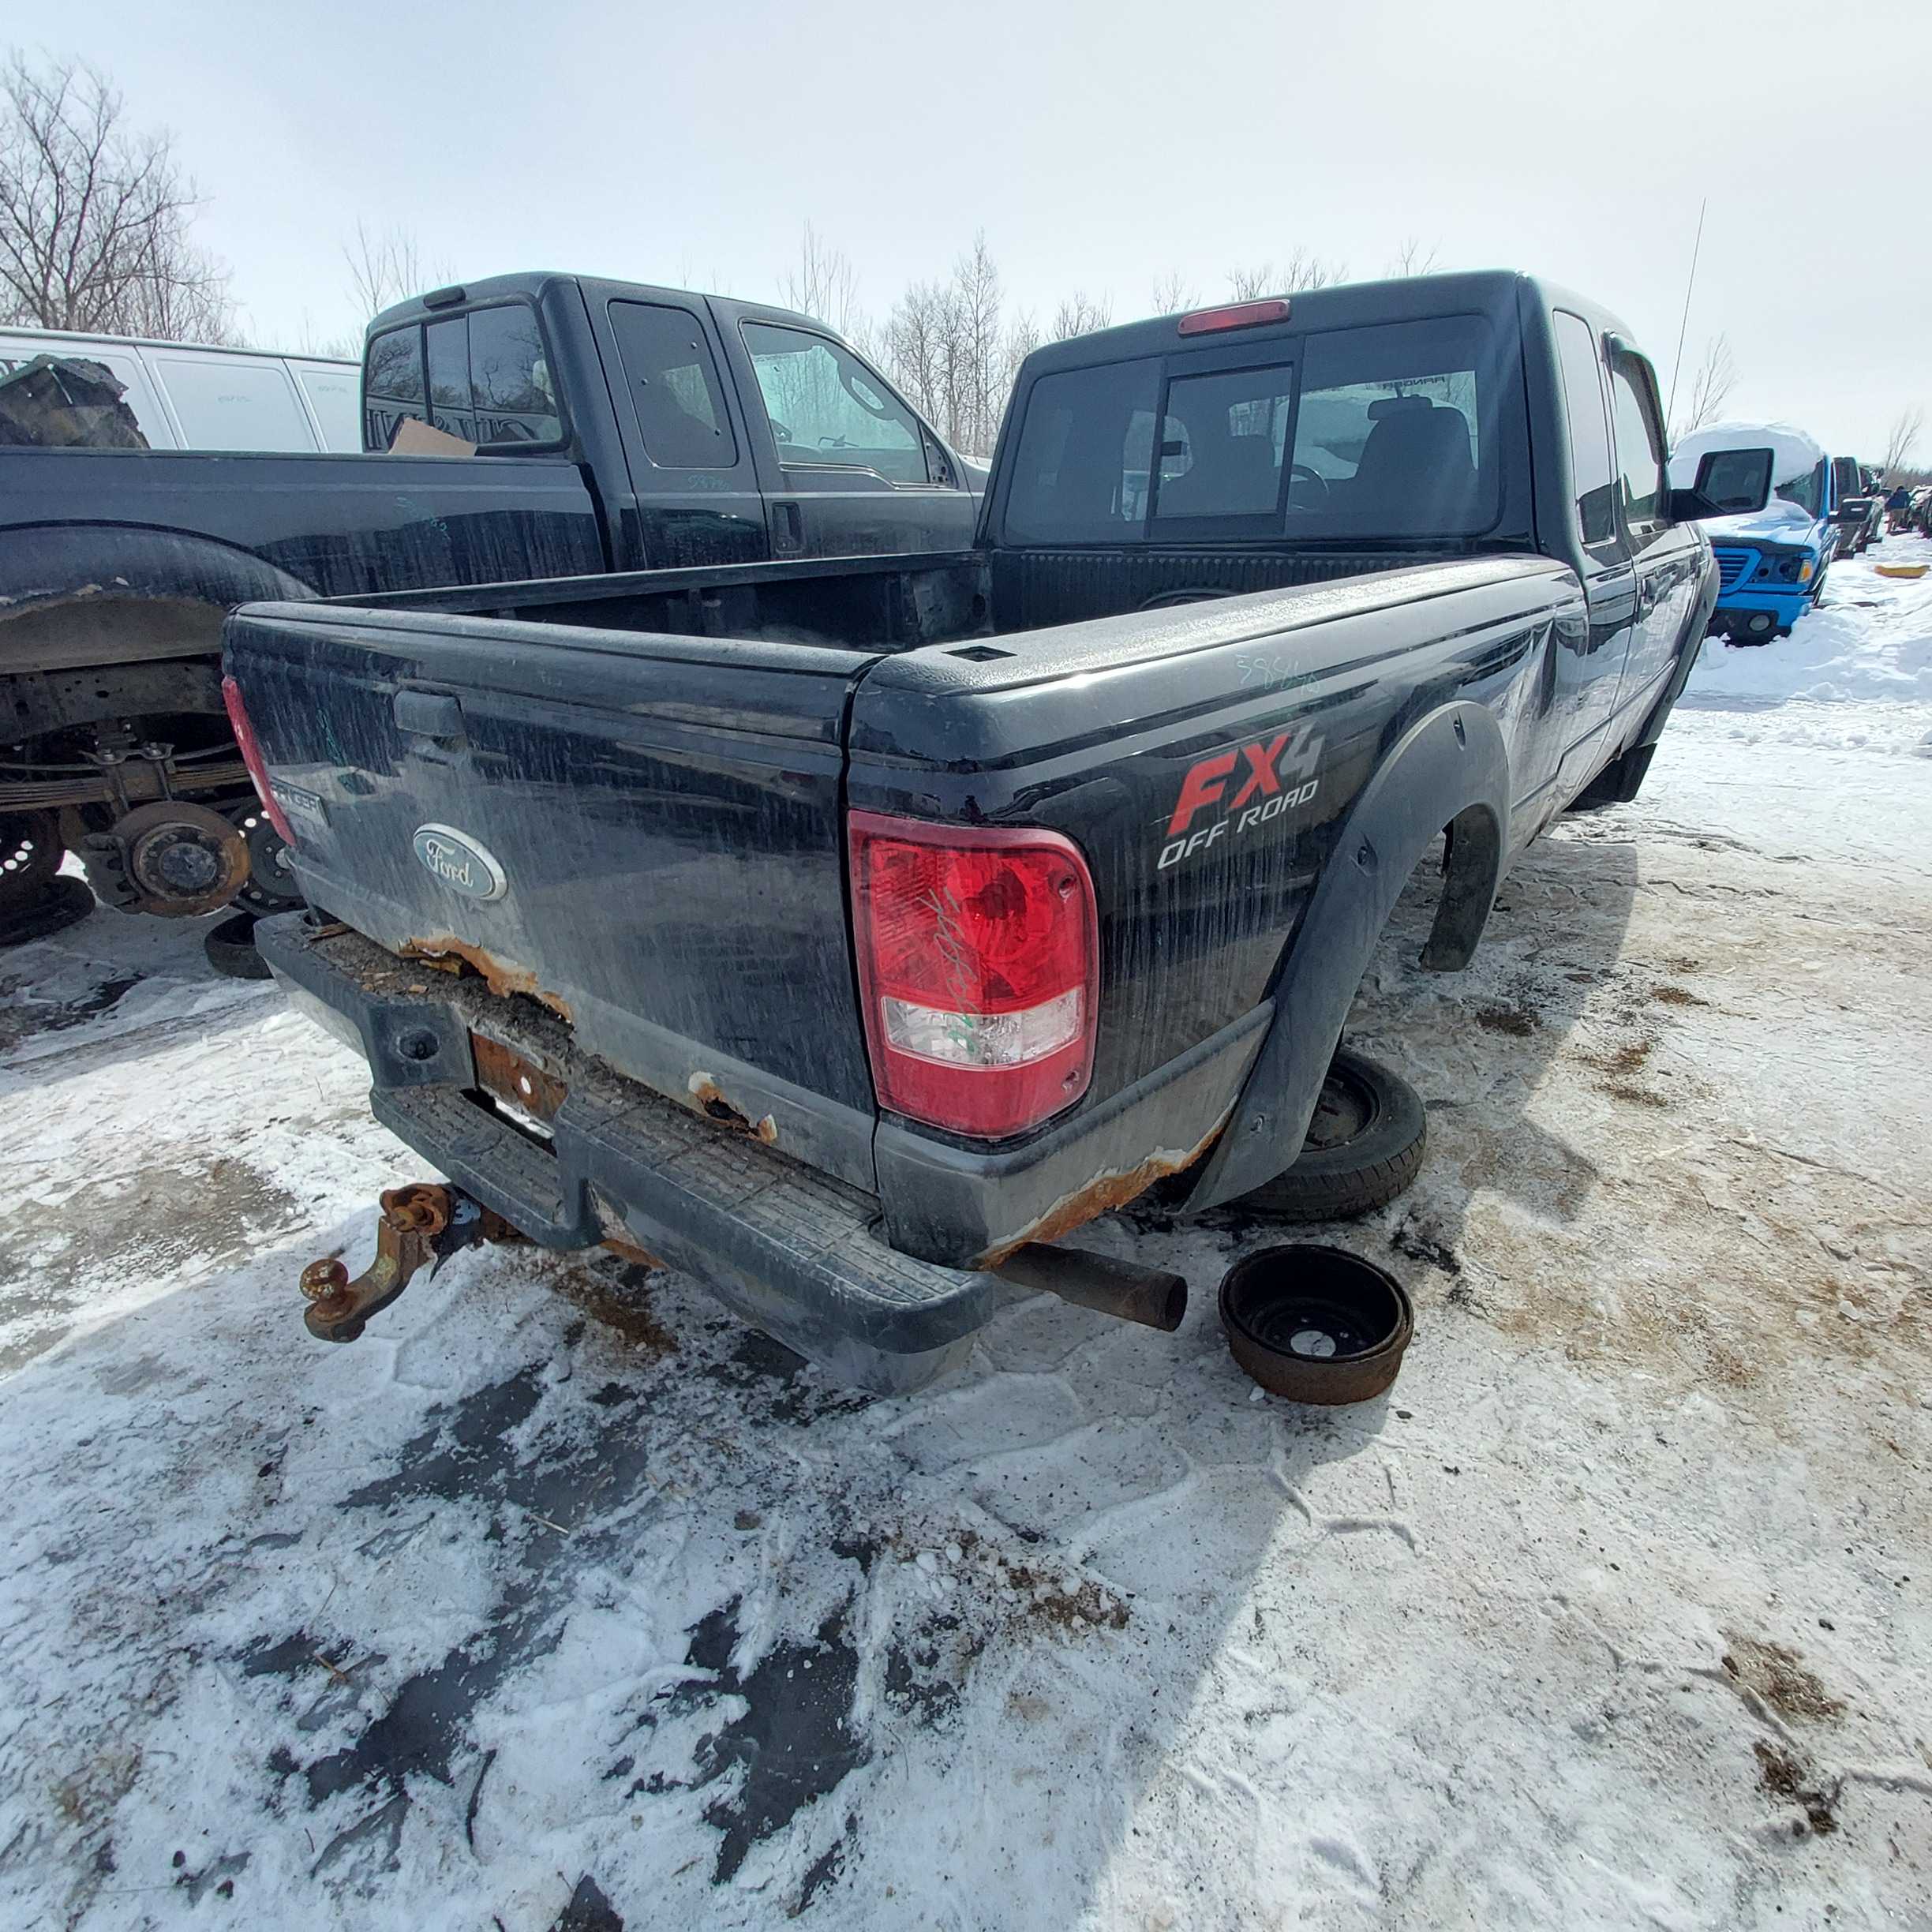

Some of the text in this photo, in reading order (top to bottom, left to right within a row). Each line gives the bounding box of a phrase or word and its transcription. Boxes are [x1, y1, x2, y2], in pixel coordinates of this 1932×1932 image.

[1166, 721, 1325, 837] FX4
[426, 838, 474, 888] Ford
[1157, 780, 1319, 870] OFF ROAD
